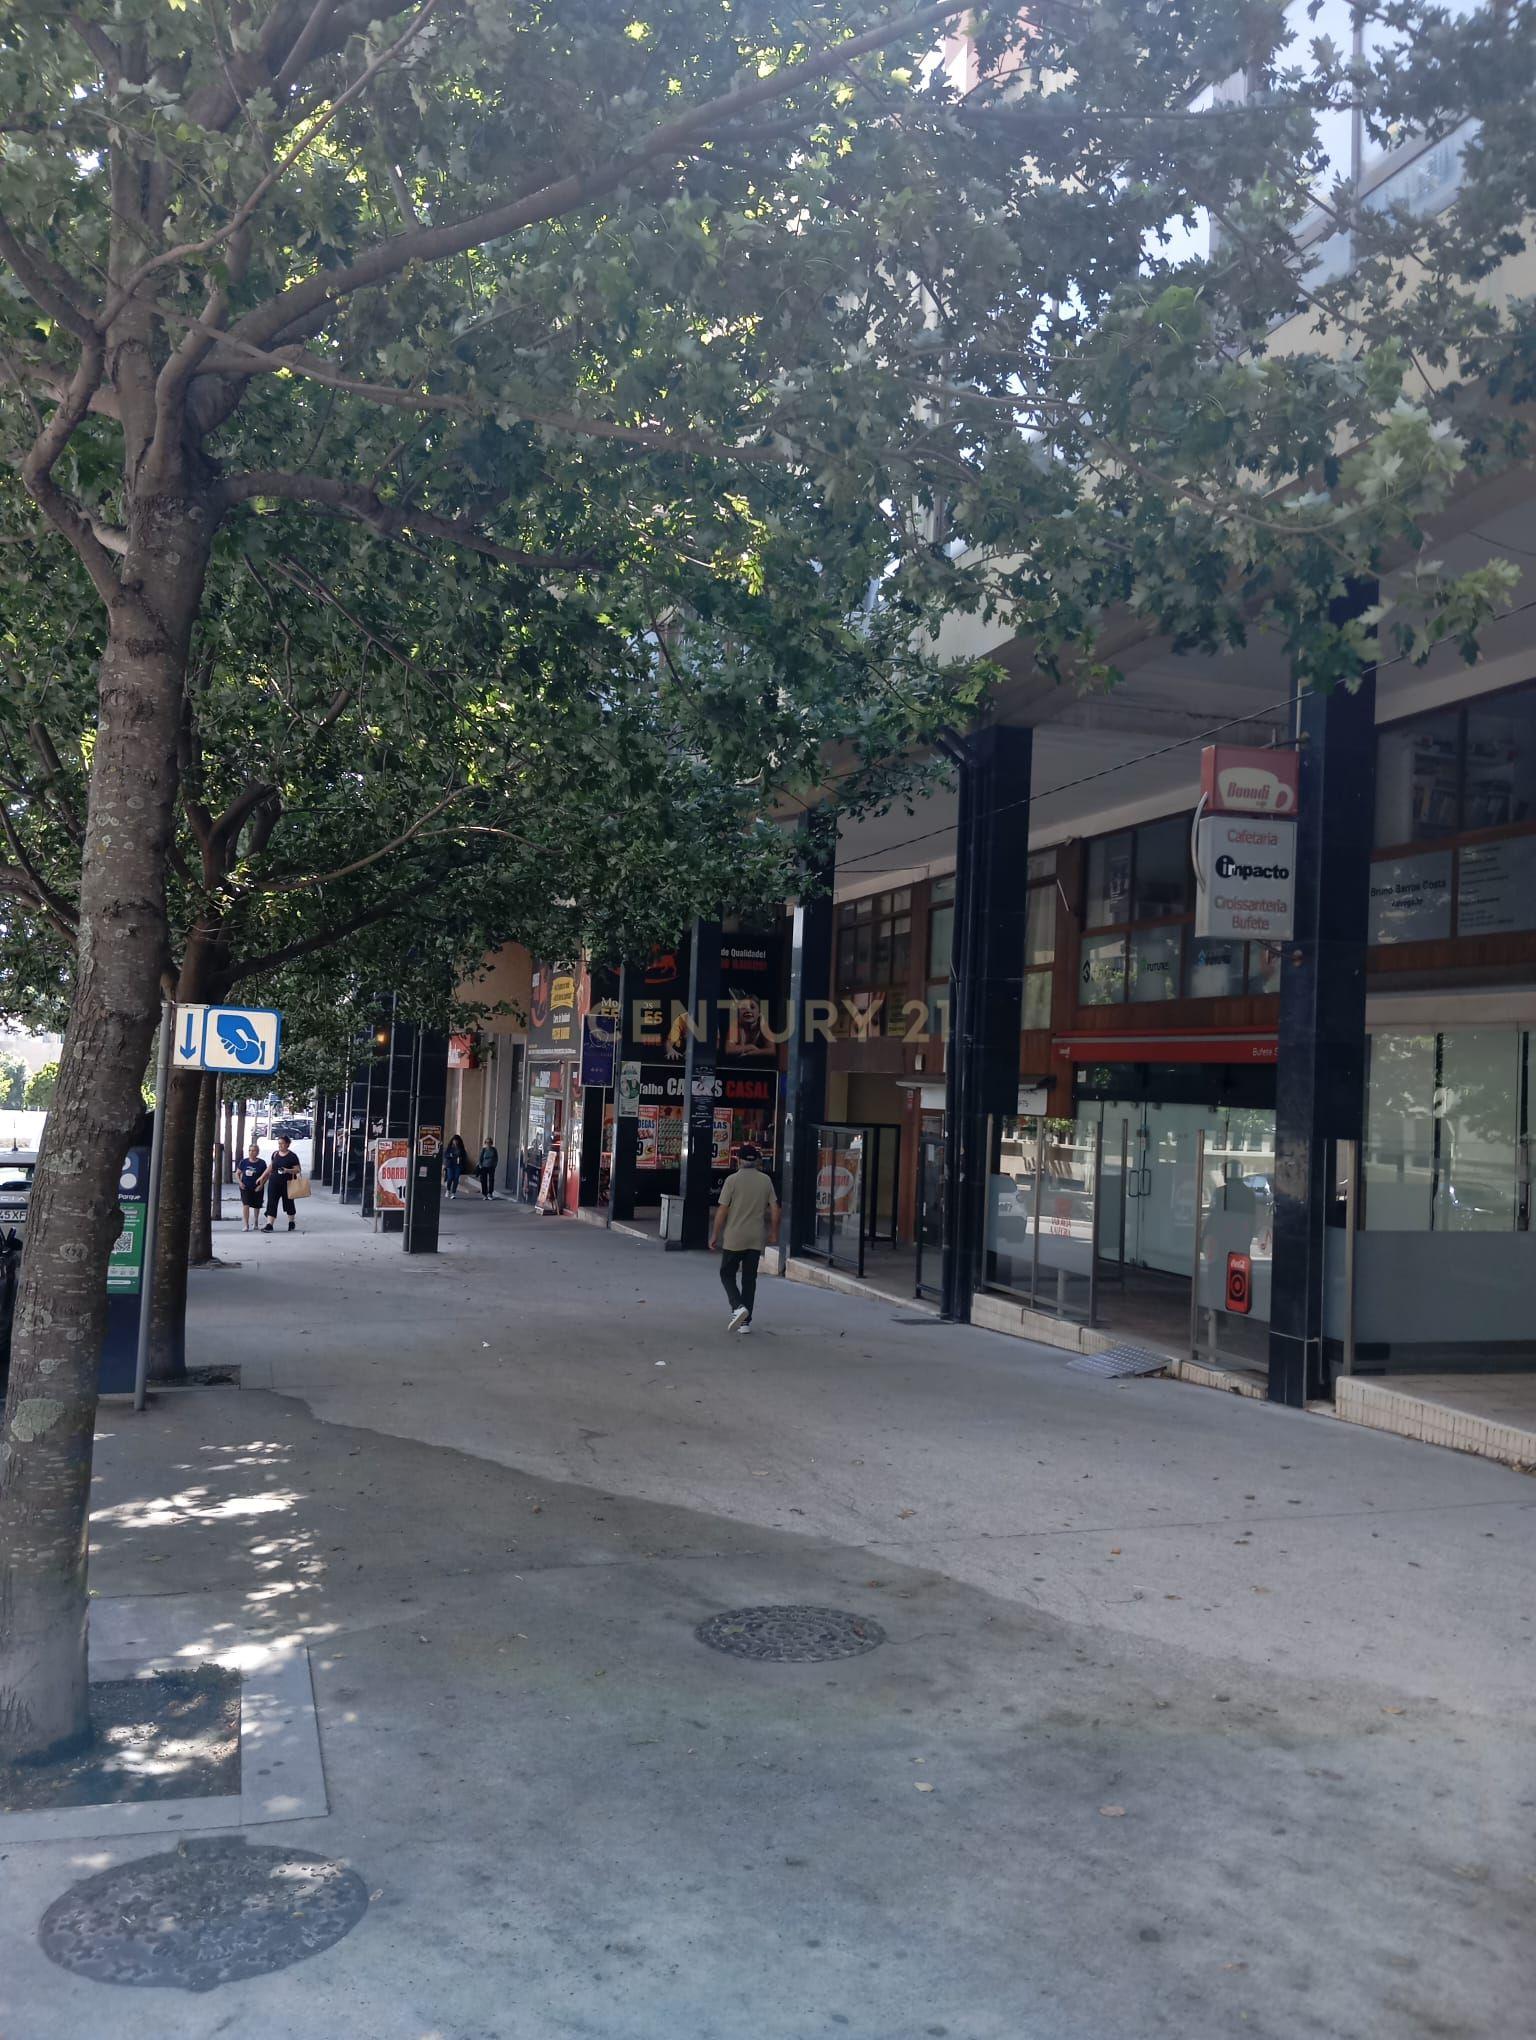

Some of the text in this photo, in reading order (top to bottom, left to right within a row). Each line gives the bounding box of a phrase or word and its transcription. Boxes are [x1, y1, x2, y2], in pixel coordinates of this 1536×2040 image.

[1227, 829, 1279, 846] Cafetaria
[1215, 855, 1289, 880] impacto
[1214, 895, 1288, 914] Croissanteria
[1232, 914, 1270, 931] Bufete
[725, 1079, 770, 1099] CASAL
